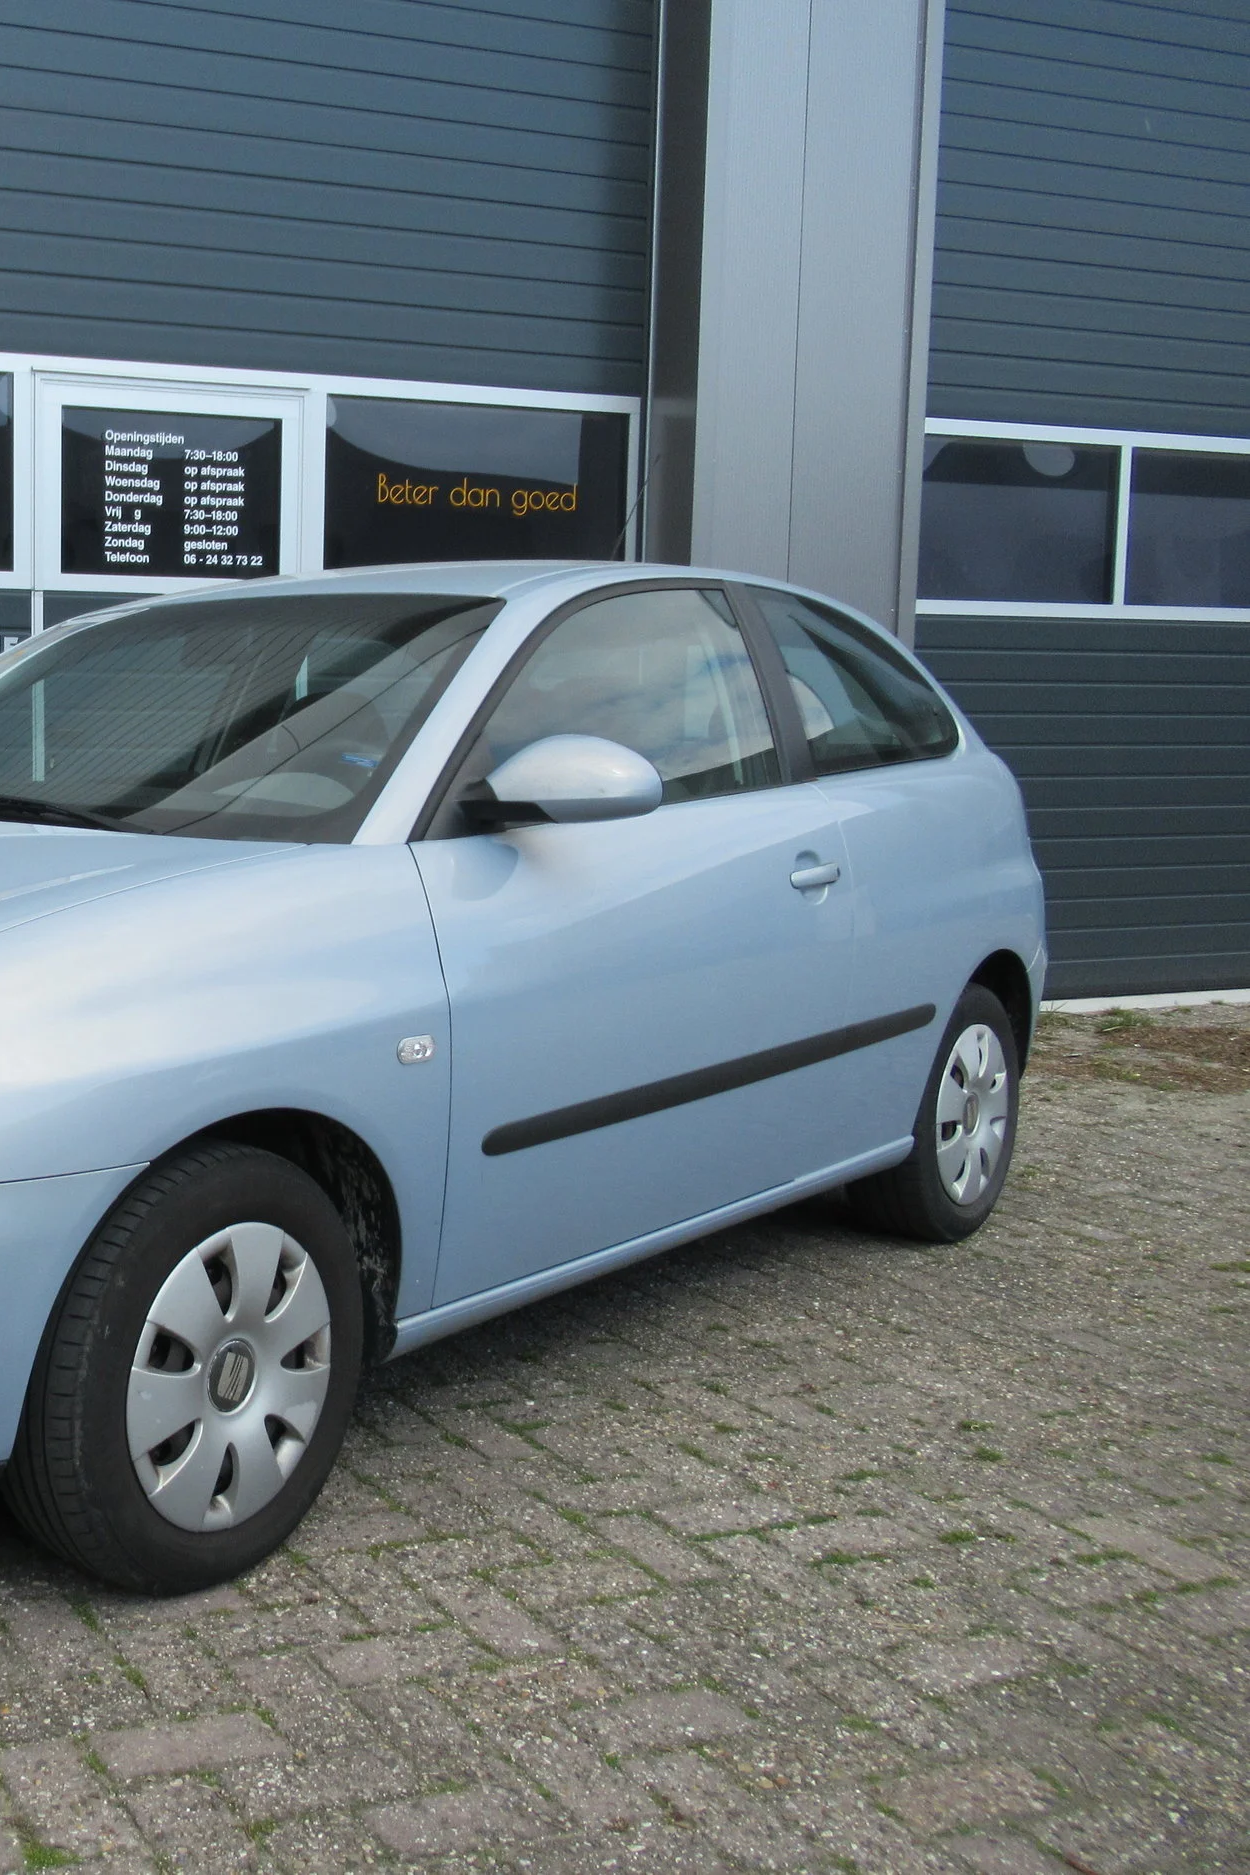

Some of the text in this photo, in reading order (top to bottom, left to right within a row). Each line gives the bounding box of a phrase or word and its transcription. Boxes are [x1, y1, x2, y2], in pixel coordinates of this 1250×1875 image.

[105, 429, 185, 446] Openingstijden
[104, 445, 153, 460] Maandag
[104, 460, 245, 478] Dinsdag op afspraak
[104, 475, 245, 493] Woensdag op afspraak
[104, 490, 245, 508] Donderdag op afspraak
[377, 472, 578, 516] Beter dan goed
[104, 521, 151, 535] Zaterdag
[104, 536, 228, 552] Zondag gesloten
[104, 551, 150, 564] Telefoon
[184, 554, 197, 565] 06
[205, 554, 218, 565] 24
[221, 555, 233, 566] 32
[236, 555, 248, 566] 73
[250, 555, 263, 566] 22
